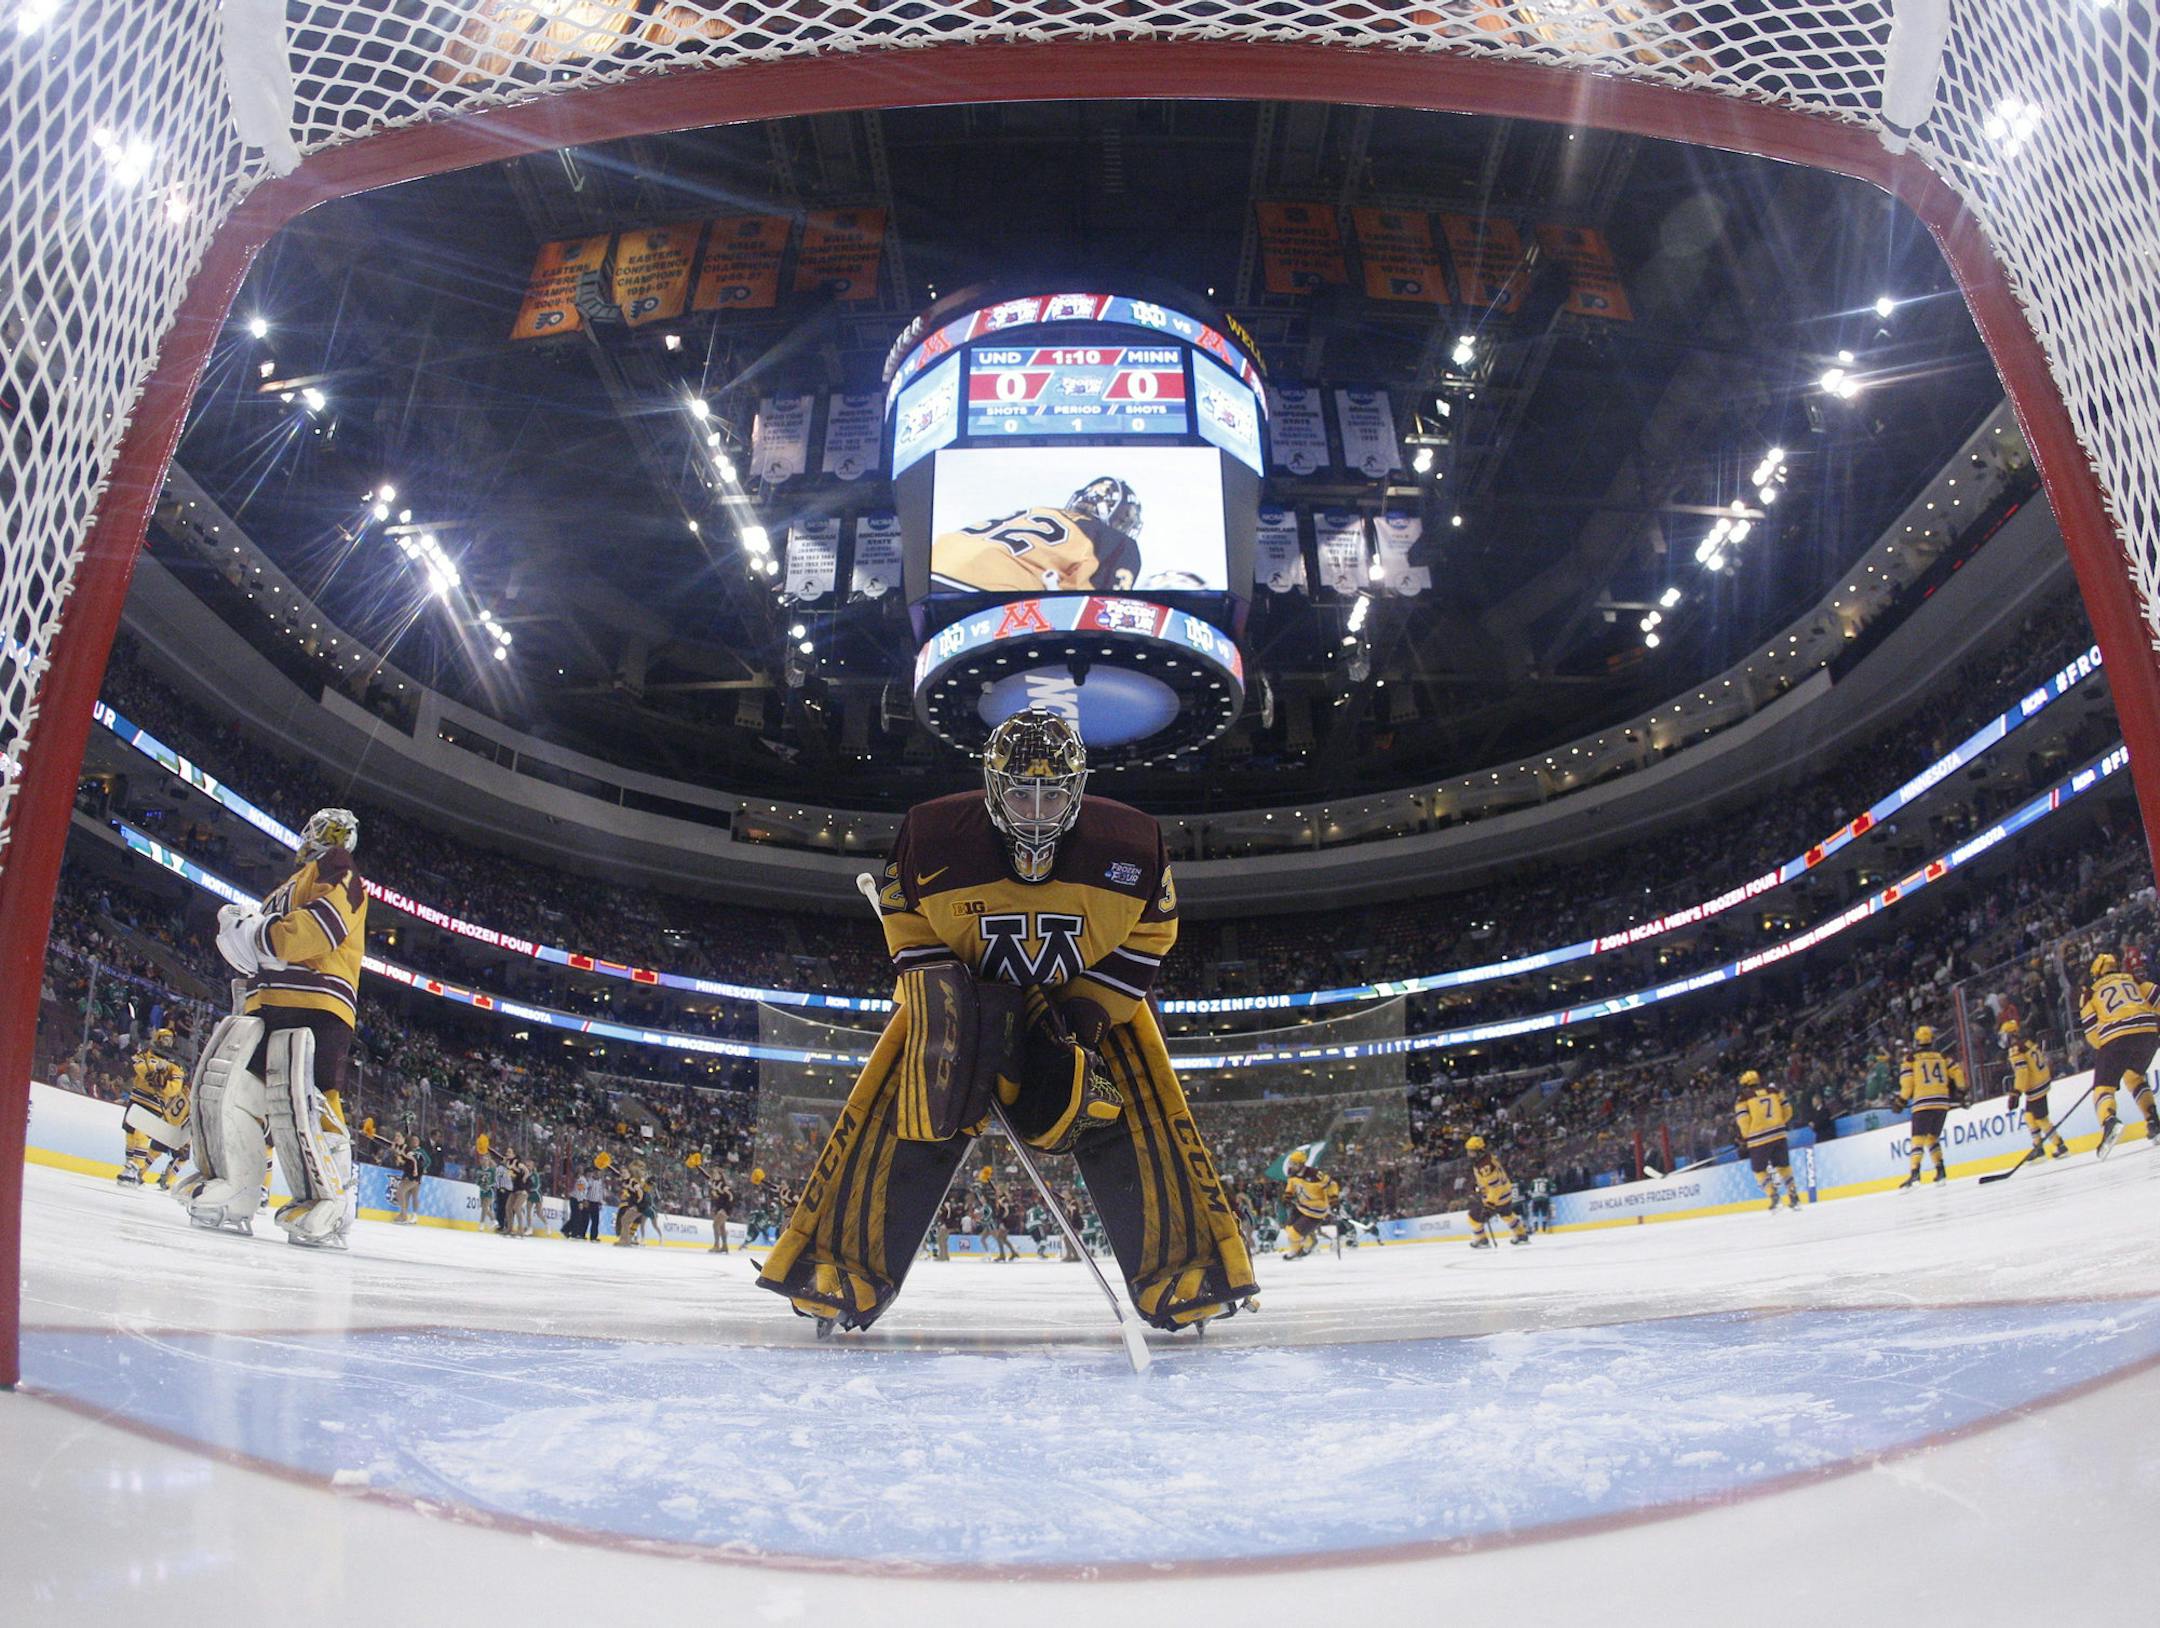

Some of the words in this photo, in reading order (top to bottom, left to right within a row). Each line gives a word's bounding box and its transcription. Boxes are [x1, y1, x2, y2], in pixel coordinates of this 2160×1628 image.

[617, 269, 684, 288] CHAMPIONS
[523, 286, 578, 301] CHAMPIO
[979, 352, 1022, 364] UND
[1052, 350, 1101, 364] 1:10
[1127, 351, 1179, 364] MINN
[996, 372, 1027, 400] 0
[1127, 372, 1158, 400] 0
[986, 407, 1027, 416] SHOTS
[1054, 406, 1102, 415] PERIOD
[1125, 405, 1167, 414] SHOTS
[1004, 419, 1018, 432] 0
[1071, 418, 1082, 432] 1
[1132, 418, 1145, 431] 0
[794, 534, 838, 543] MICHIGAN
[858, 531, 902, 539] MICHIGAN
[246, 806, 284, 844] NORTH
[1110, 871, 1139, 882] FOUR
[1111, 862, 1142, 876] FROZEN
[1600, 931, 1629, 951] 2014
[1629, 920, 1665, 942] NCAA
[1664, 906, 1702, 930] MEN'S
[1702, 886, 1745, 916] FROZEN
[1746, 870, 1778, 896] FOUR
[383, 888, 416, 914] NCAA
[417, 904, 450, 928] MEN'S
[451, 918, 499, 945] FROZEN
[500, 934, 533, 955] FOUR
[979, 911, 1085, 987] M
[386, 965, 412, 984] FOUR
[695, 980, 764, 1001] MINNESOTA
[2100, 982, 2143, 1014] 20
[501, 1002, 553, 1024] MINNESOTA
[1164, 995, 1290, 1013] #FROZENFOUR
[936, 979, 958, 1092] CCM
[1920, 1061, 1944, 1085] 14
[1759, 1098, 1773, 1118] 7
[1890, 1132, 1948, 1160] NOH
[1953, 1108, 2027, 1145] DAKOTA
[299, 1130, 324, 1187] CCM
[804, 1111, 857, 1213] CCM
[1174, 1119, 1229, 1213] CCM
[1805, 1147, 1815, 1188] NCAA
[1604, 1196, 1623, 1209] NCAA
[1624, 1193, 1645, 1206] MEN'S
[1646, 1187, 1678, 1203] FROZEN
[1678, 1184, 1701, 1198] FOUR
[663, 1221, 681, 1233] NORTH
[681, 1223, 698, 1235] DAKOTA
